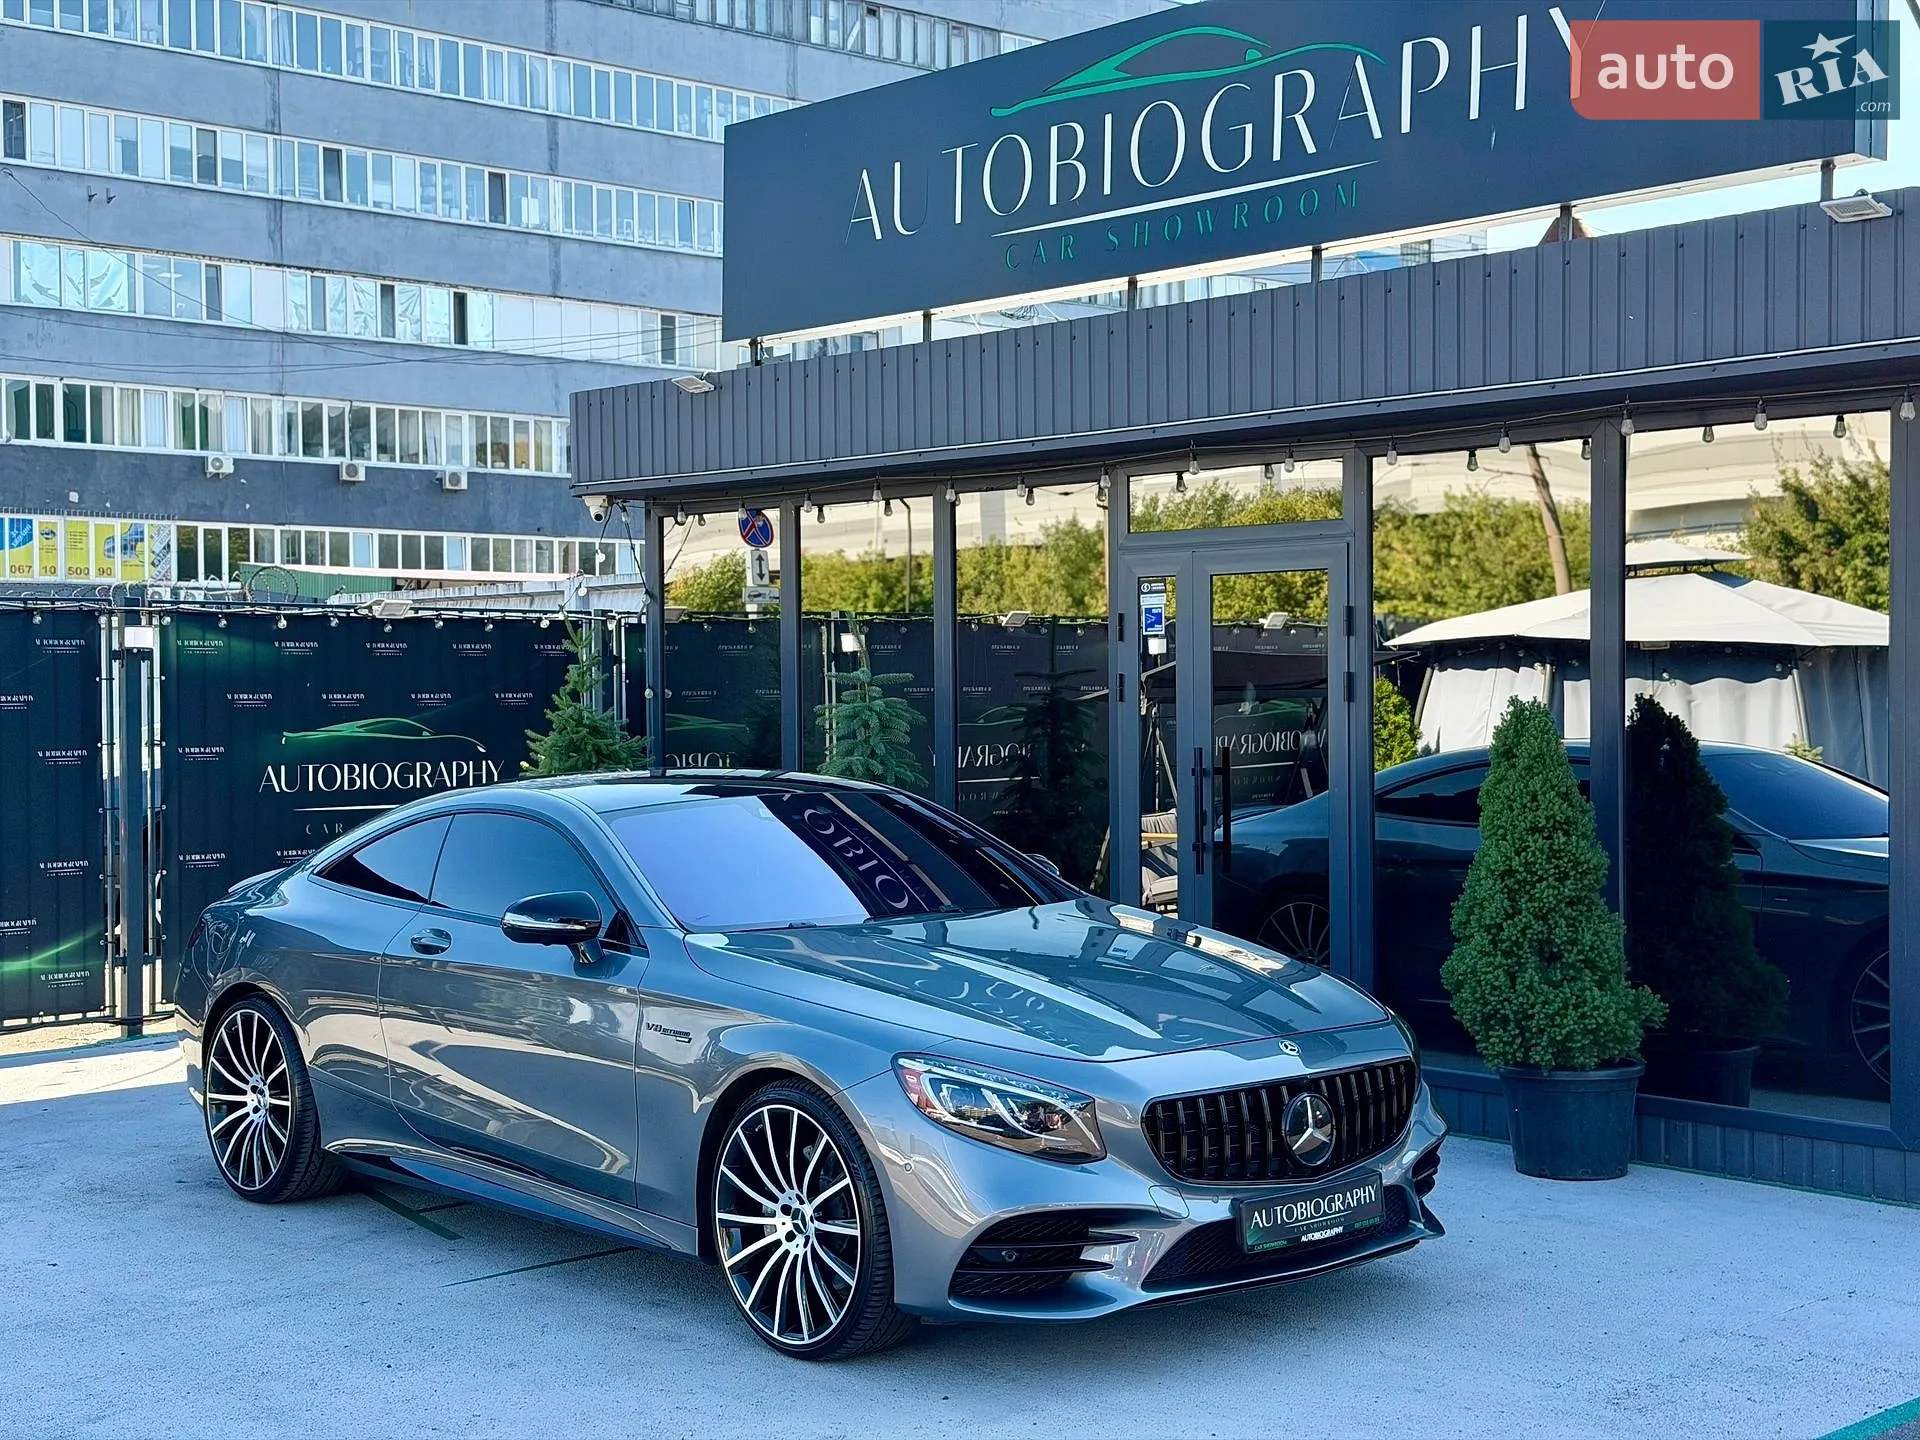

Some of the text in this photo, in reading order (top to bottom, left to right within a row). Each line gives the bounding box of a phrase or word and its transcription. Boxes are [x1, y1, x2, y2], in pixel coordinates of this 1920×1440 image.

[845, 4, 1604, 244] AUTOBIOGRAPHY
[1004, 179, 1359, 271] CAR SHOWROOM
[10, 564, 113, 576] 067 10 500 90
[258, 759, 505, 793] AUTOBIOGRAPHY
[305, 822, 344, 835] CAR
[1250, 1184, 1377, 1230] AUTOBIOGRAPHY
[1300, 1225, 1344, 1243] AUTOBIOGRAPHY
